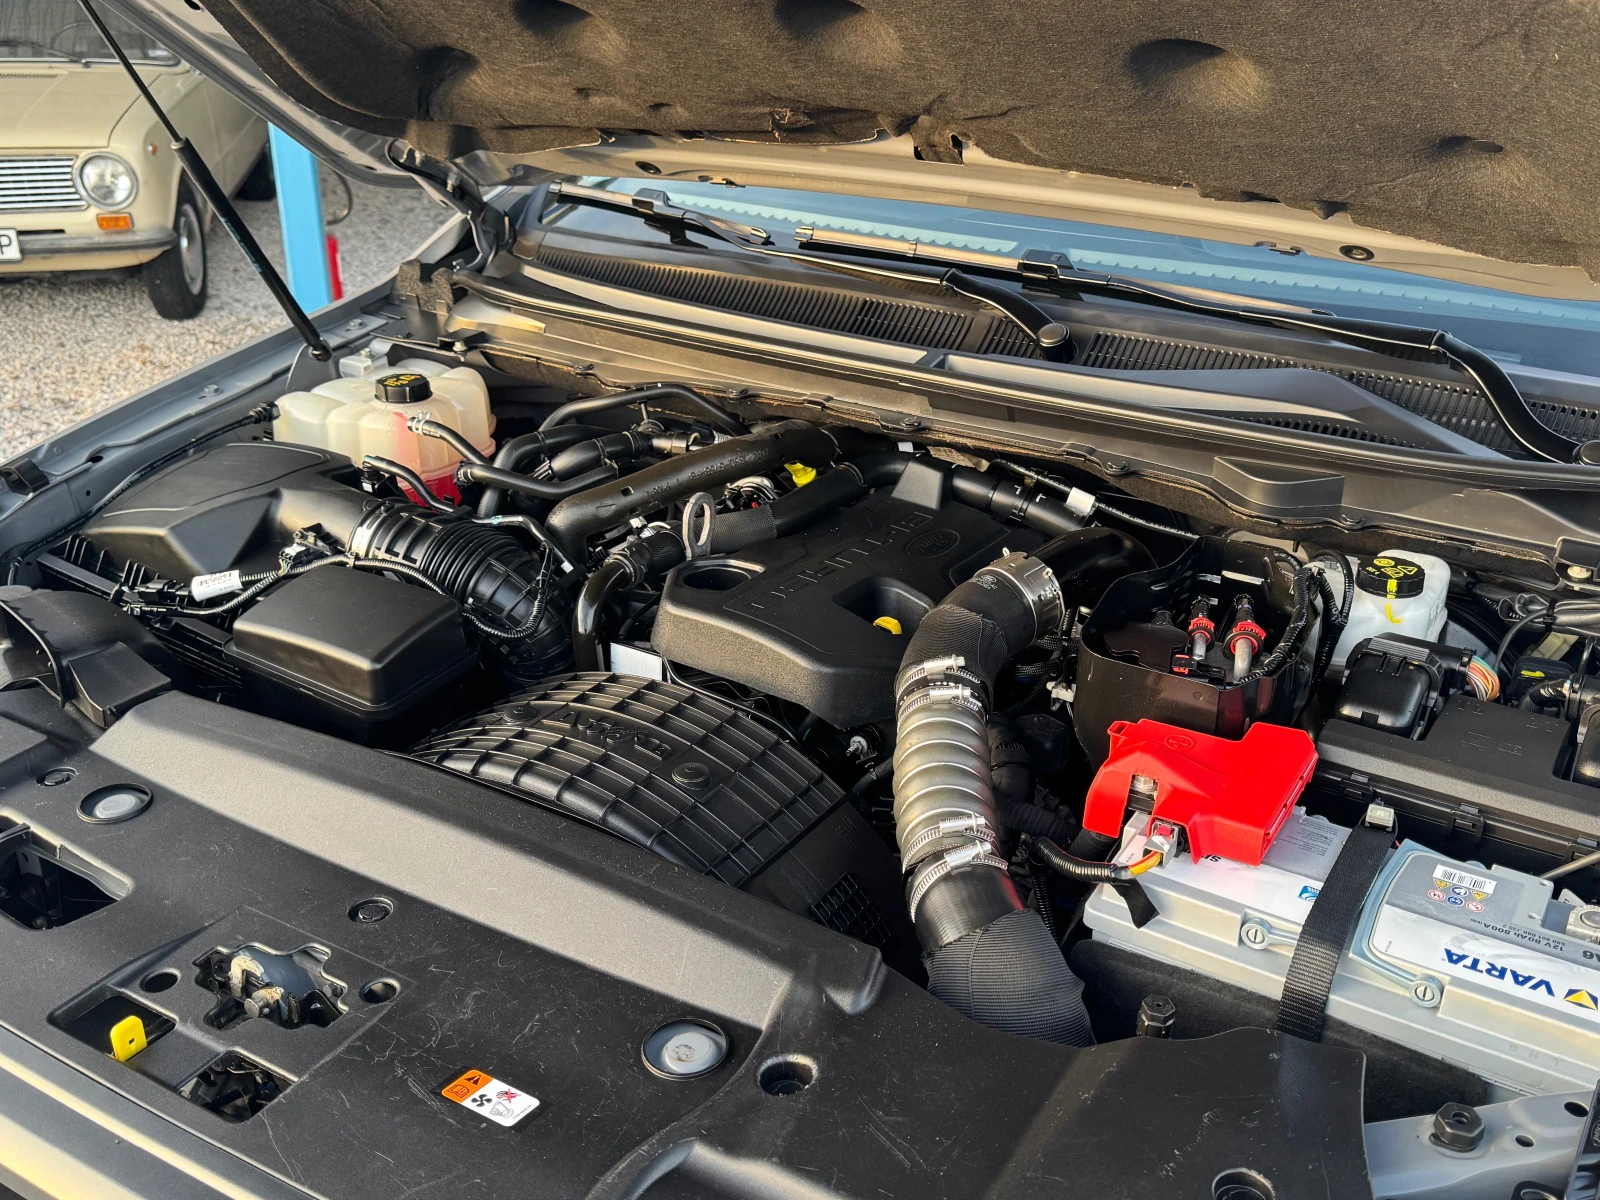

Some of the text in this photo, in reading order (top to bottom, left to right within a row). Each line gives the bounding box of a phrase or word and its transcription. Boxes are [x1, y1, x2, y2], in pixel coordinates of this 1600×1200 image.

[1513, 931, 1542, 944] 80Ah
[1544, 941, 1565, 952] 12V
[1444, 948, 1555, 997] VARTA
